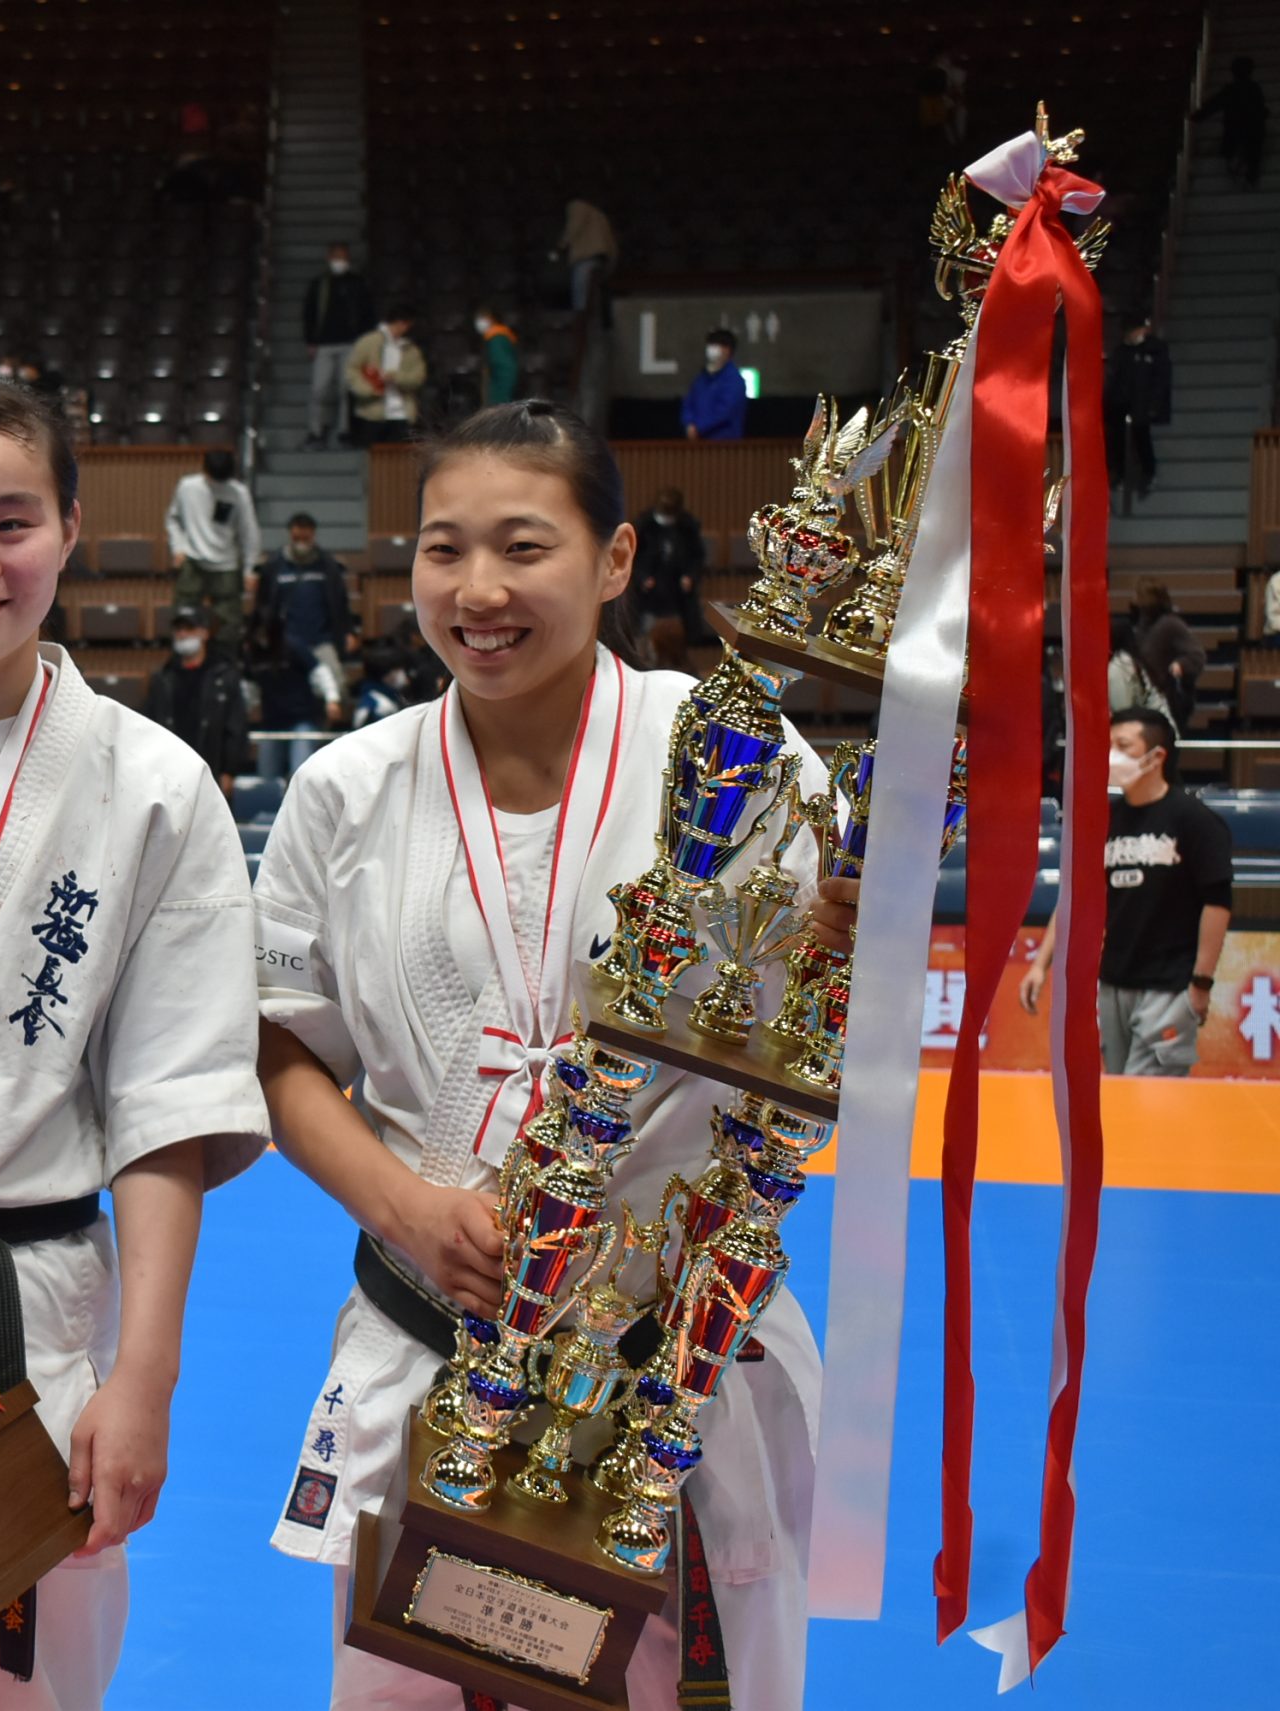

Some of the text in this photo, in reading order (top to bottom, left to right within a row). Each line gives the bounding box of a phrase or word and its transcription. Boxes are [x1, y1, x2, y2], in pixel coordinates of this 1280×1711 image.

[639, 311, 679, 374] L
[311, 1383, 344, 1463] 千尋
[454, 1583, 570, 1631] 全日本空手道選手権大会
[480, 1603, 534, 1633] 準優勝
